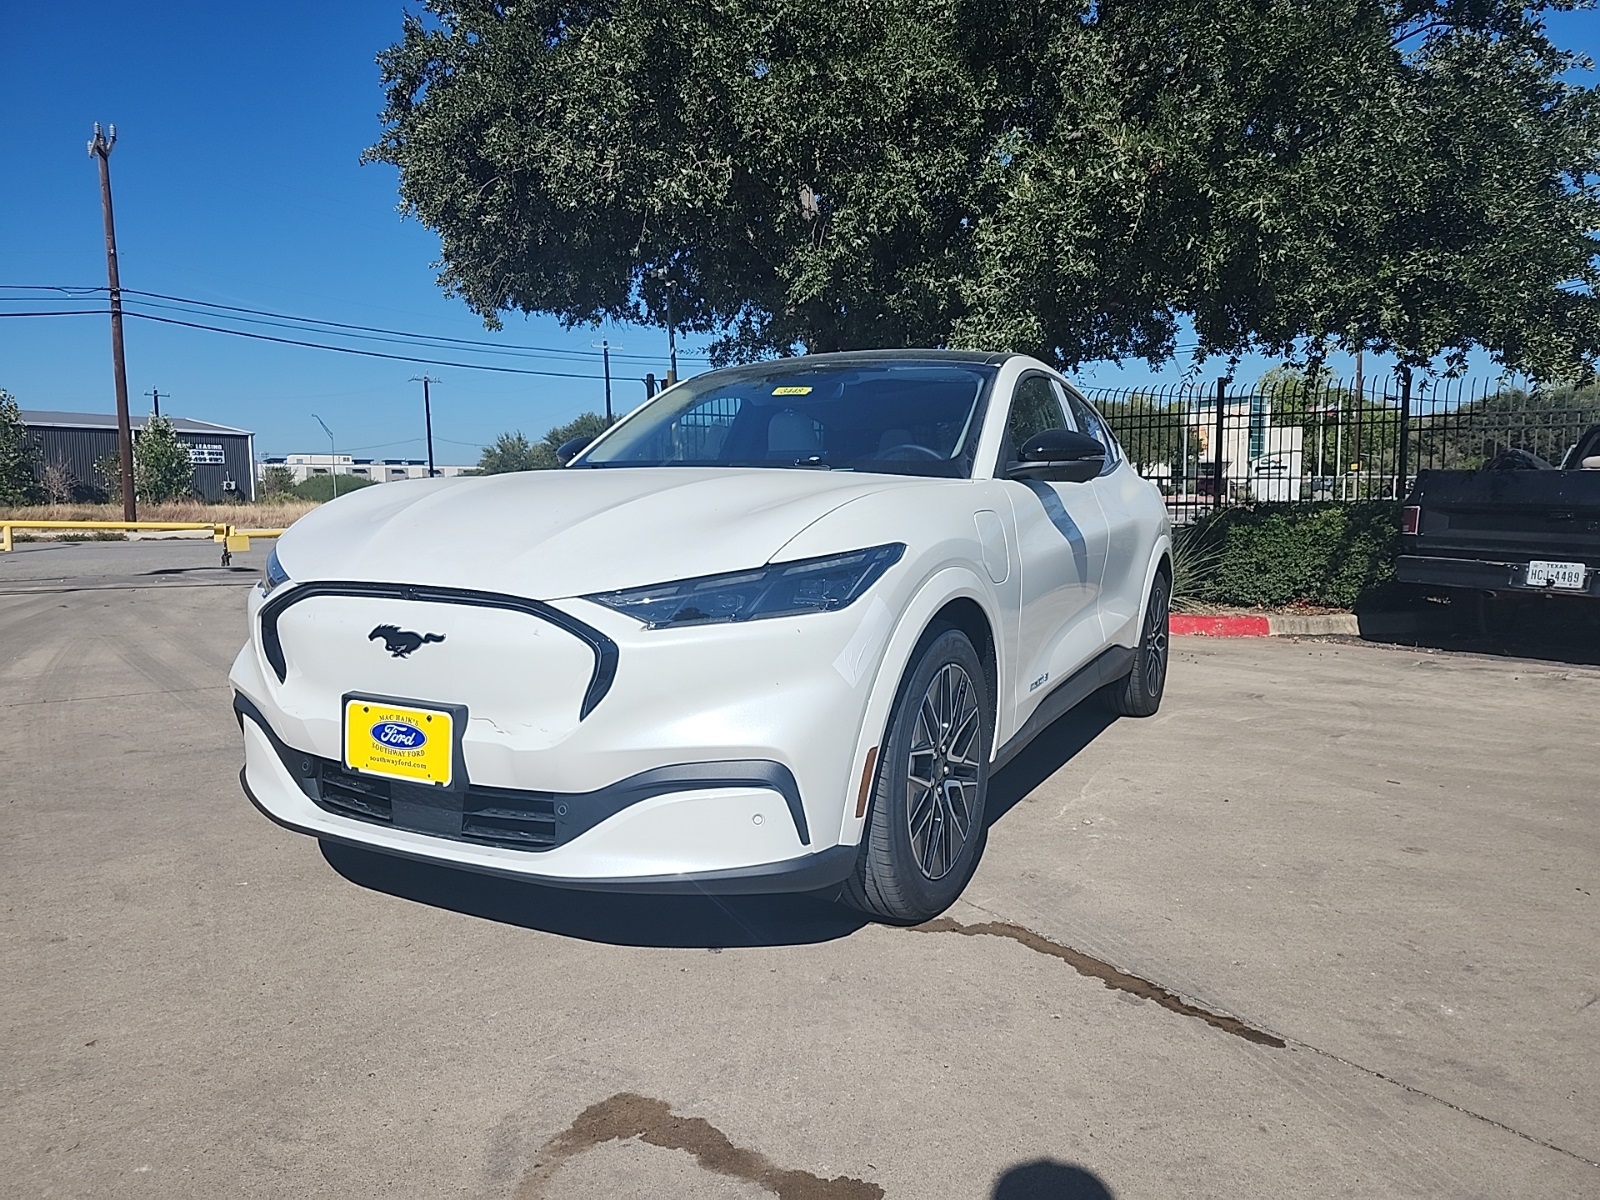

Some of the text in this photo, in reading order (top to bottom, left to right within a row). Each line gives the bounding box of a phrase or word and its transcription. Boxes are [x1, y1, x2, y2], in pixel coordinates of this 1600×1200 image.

[395, 715, 419, 726] HAIK'S
[380, 724, 416, 746] Ford
[371, 742, 425, 758] SOUTHWAY FORD
[369, 755, 427, 769] southwayford.com
